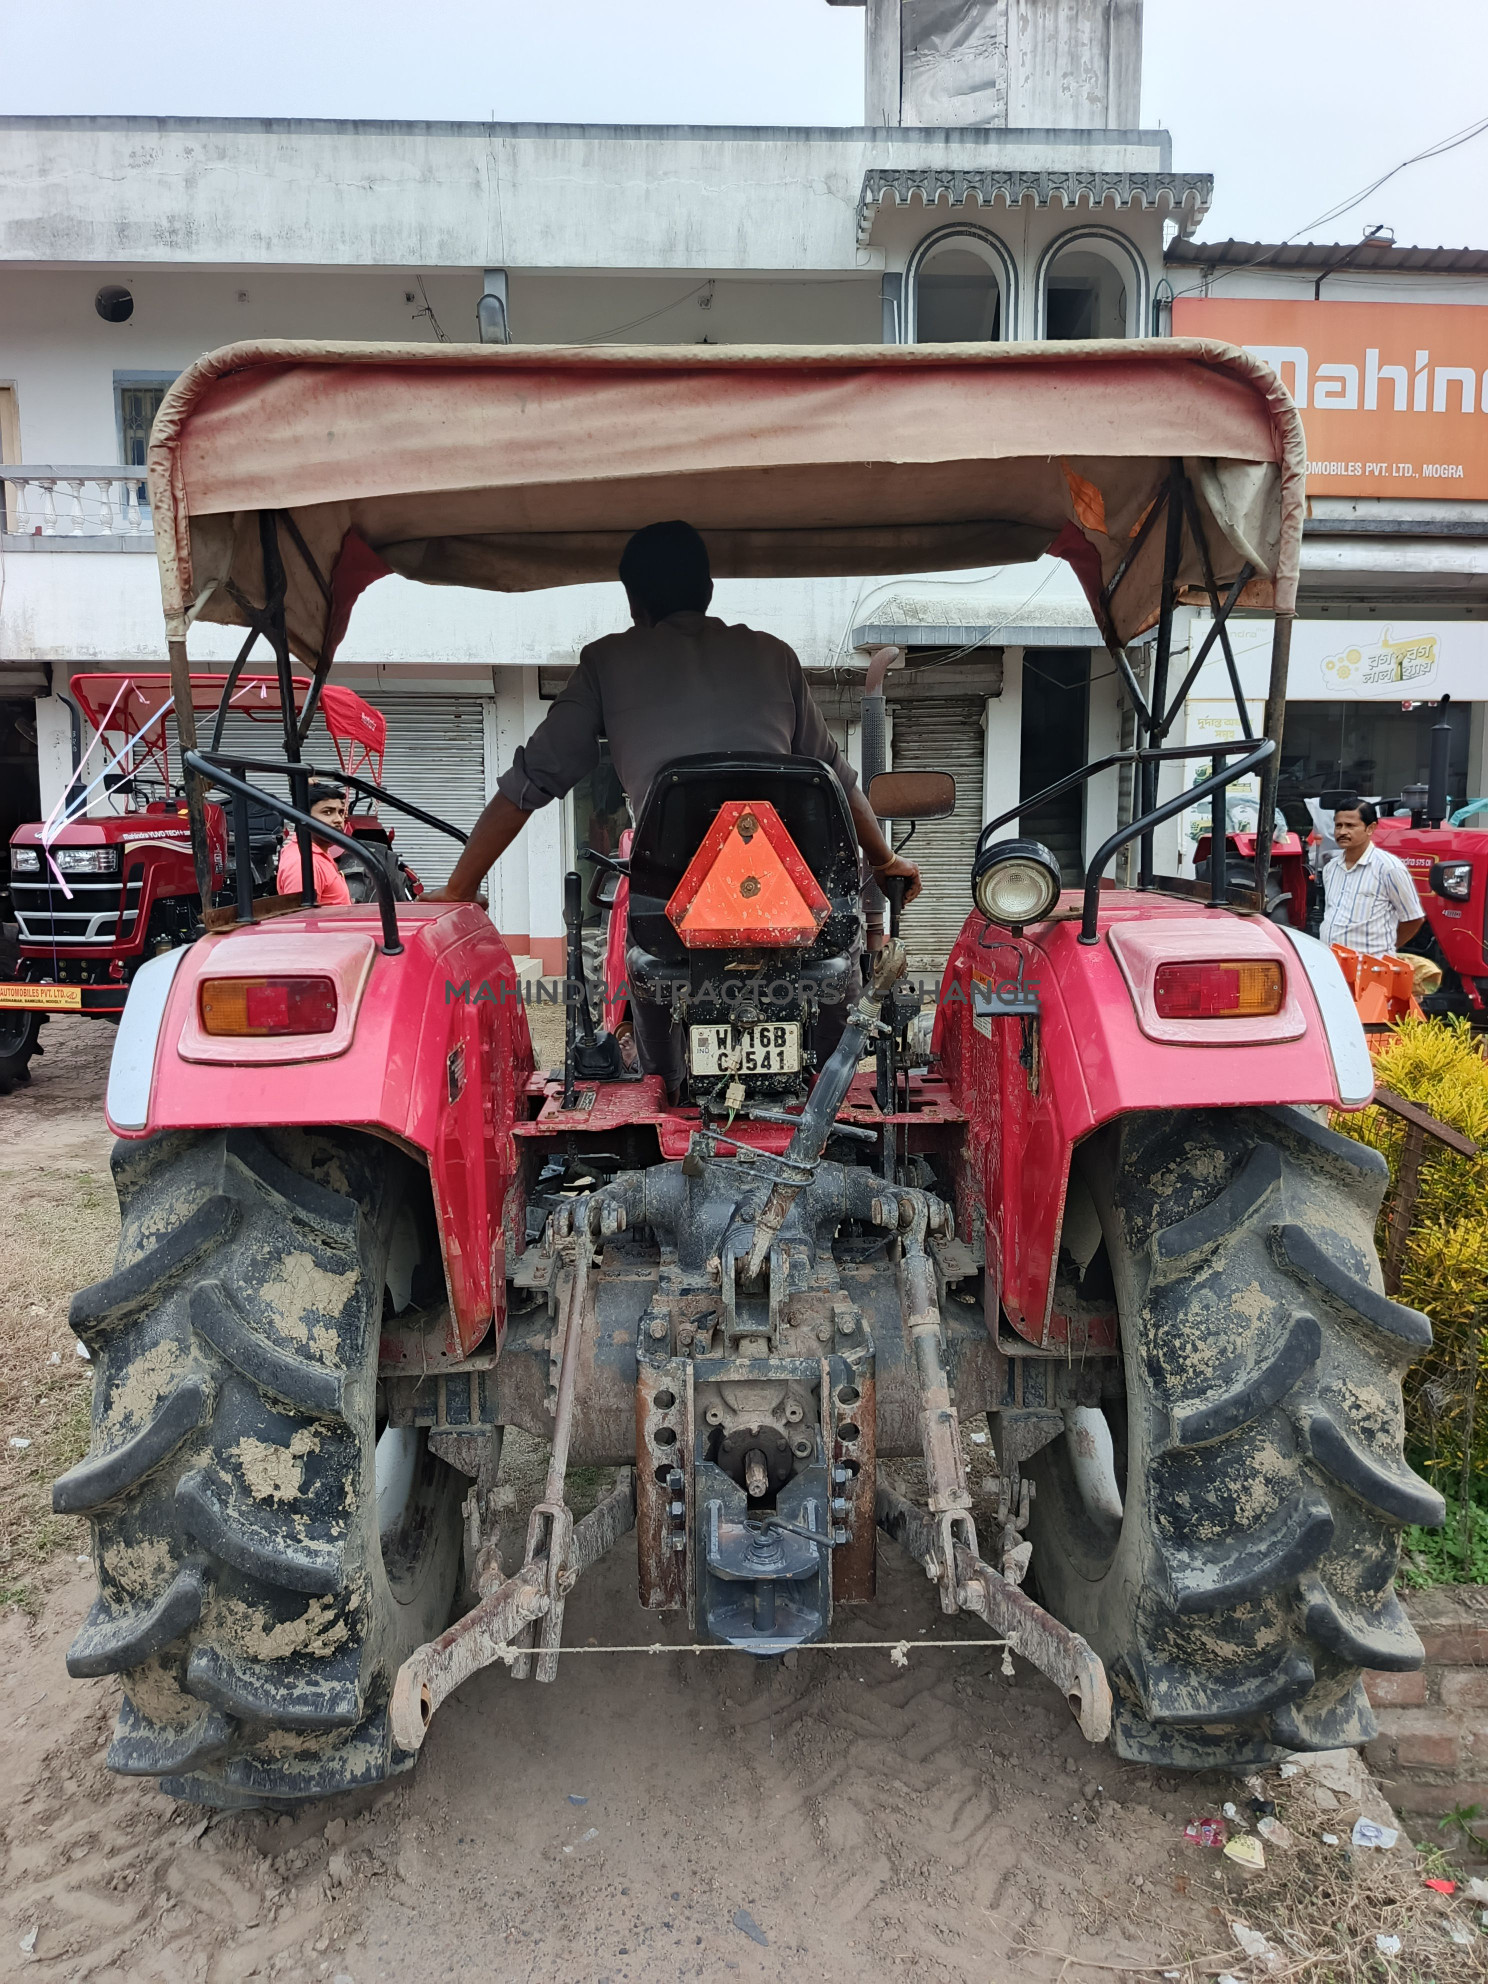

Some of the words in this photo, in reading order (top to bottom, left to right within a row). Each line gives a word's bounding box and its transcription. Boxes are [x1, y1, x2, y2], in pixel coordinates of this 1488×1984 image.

[1241, 345, 1488, 413] Mahin
[1365, 463, 1388, 477] PVT.
[1392, 463, 1419, 479] LTD.,
[1422, 464, 1464, 478] MOGRA
[0, 987, 39, 998] AUTOMOBILES
[40, 988, 53, 998] PVT.
